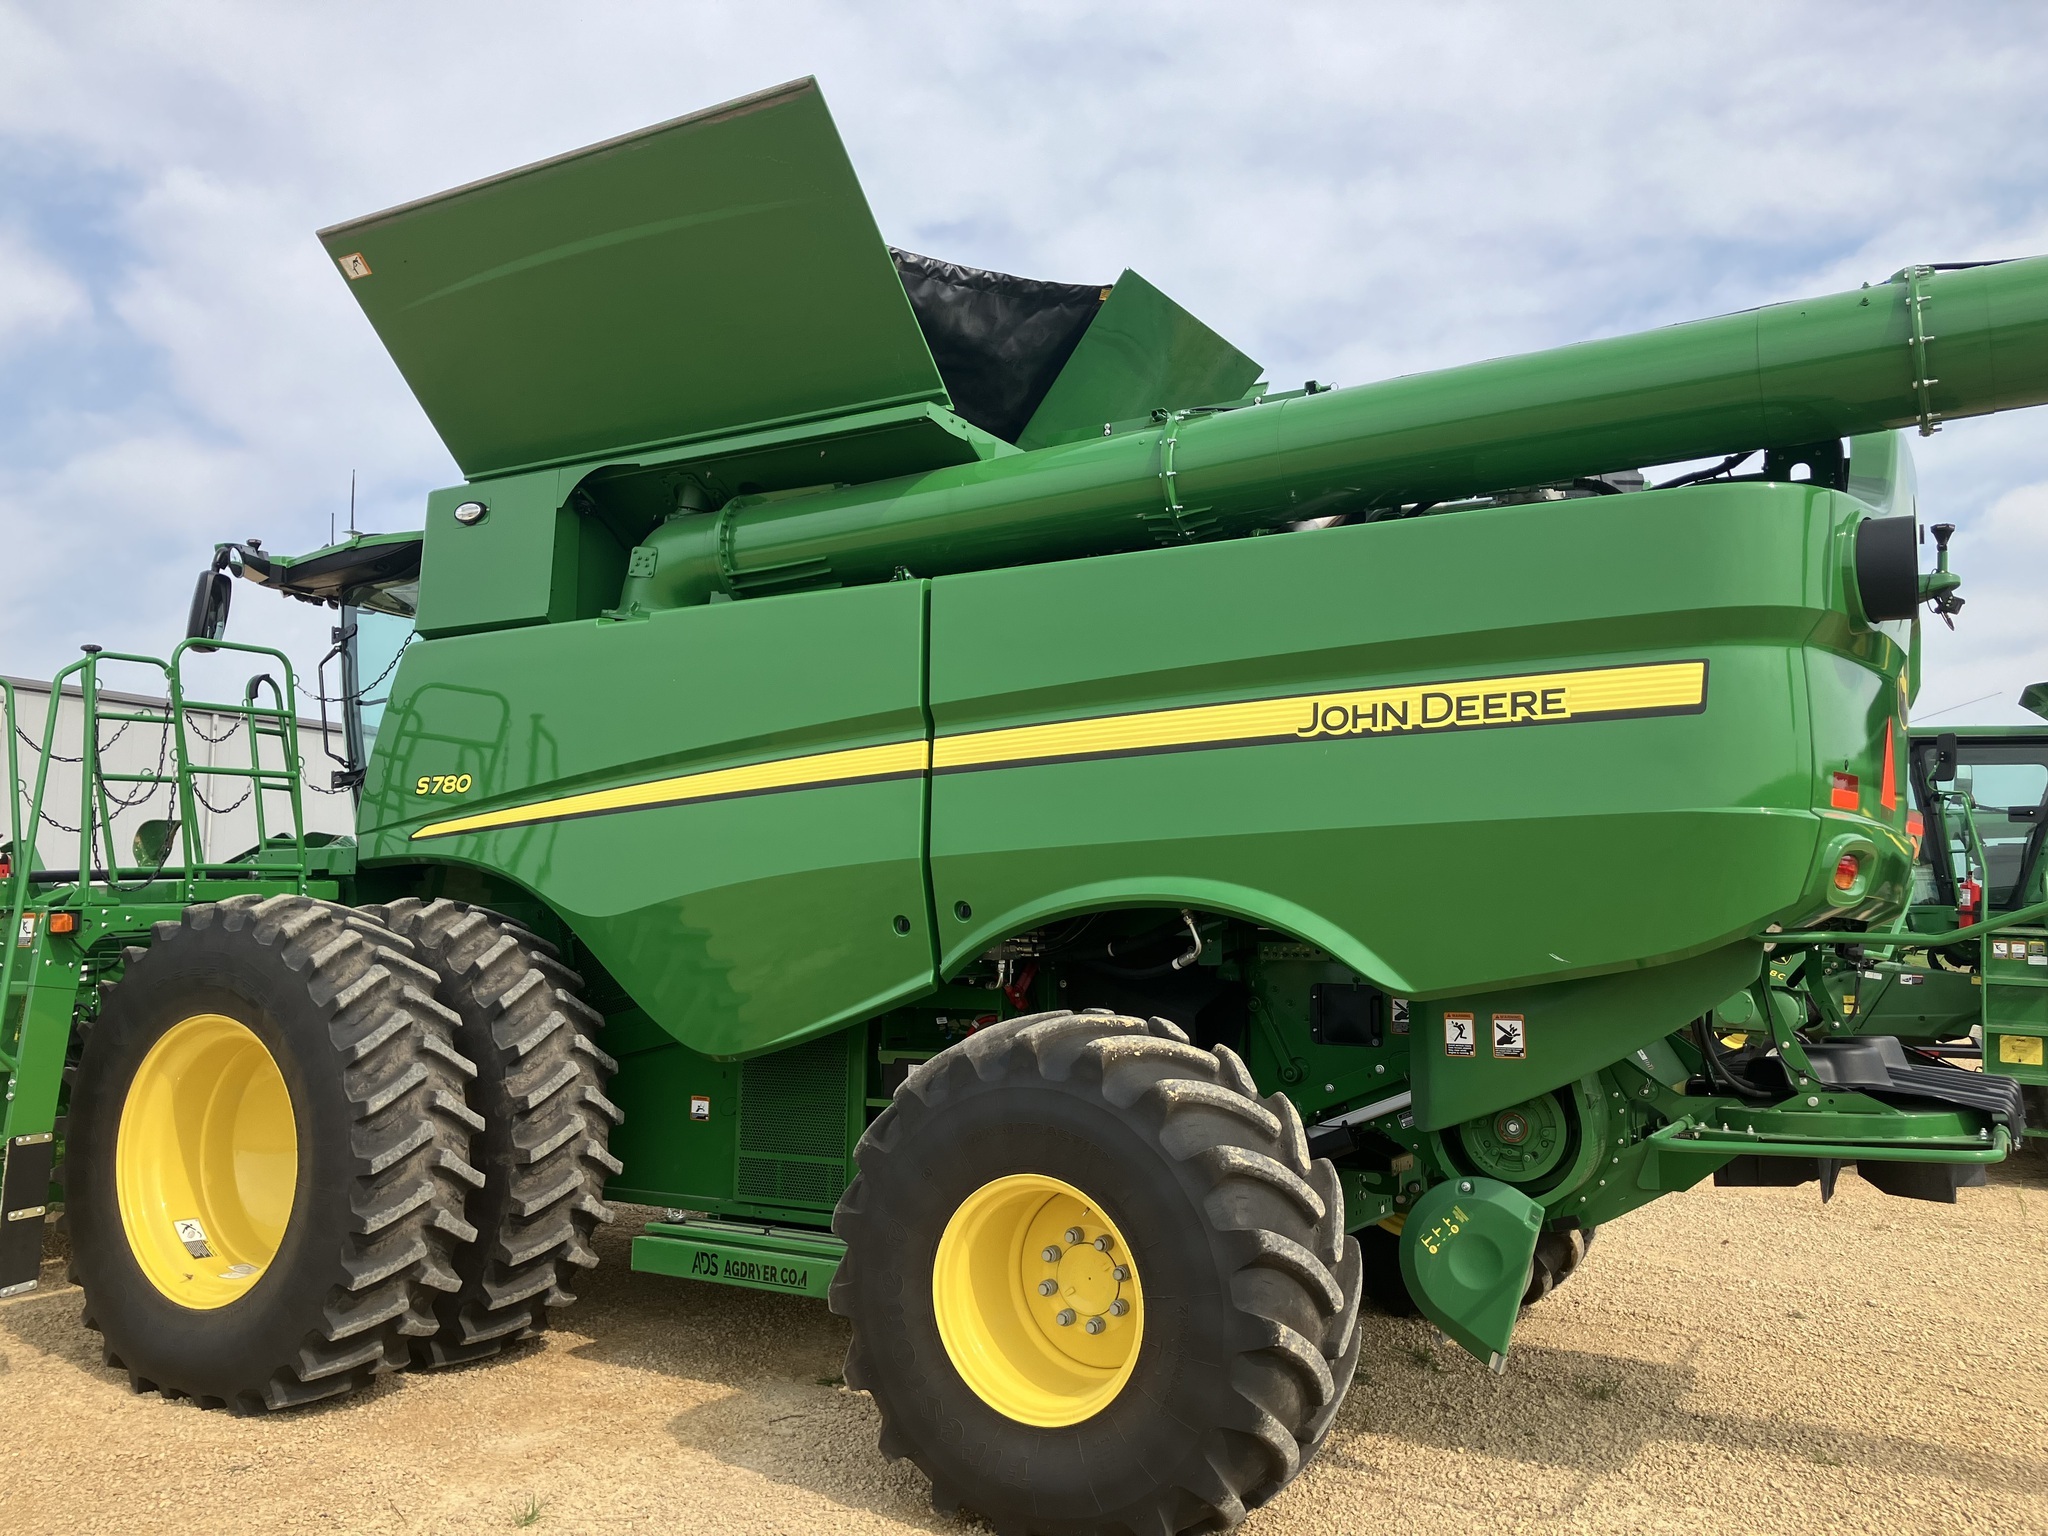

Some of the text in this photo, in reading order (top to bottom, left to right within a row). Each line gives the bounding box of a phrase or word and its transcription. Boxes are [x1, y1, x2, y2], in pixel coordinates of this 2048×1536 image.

[1297, 688, 1566, 734] JOHN DEERE
[415, 773, 472, 795] S780
[691, 1251, 719, 1276] ADS
